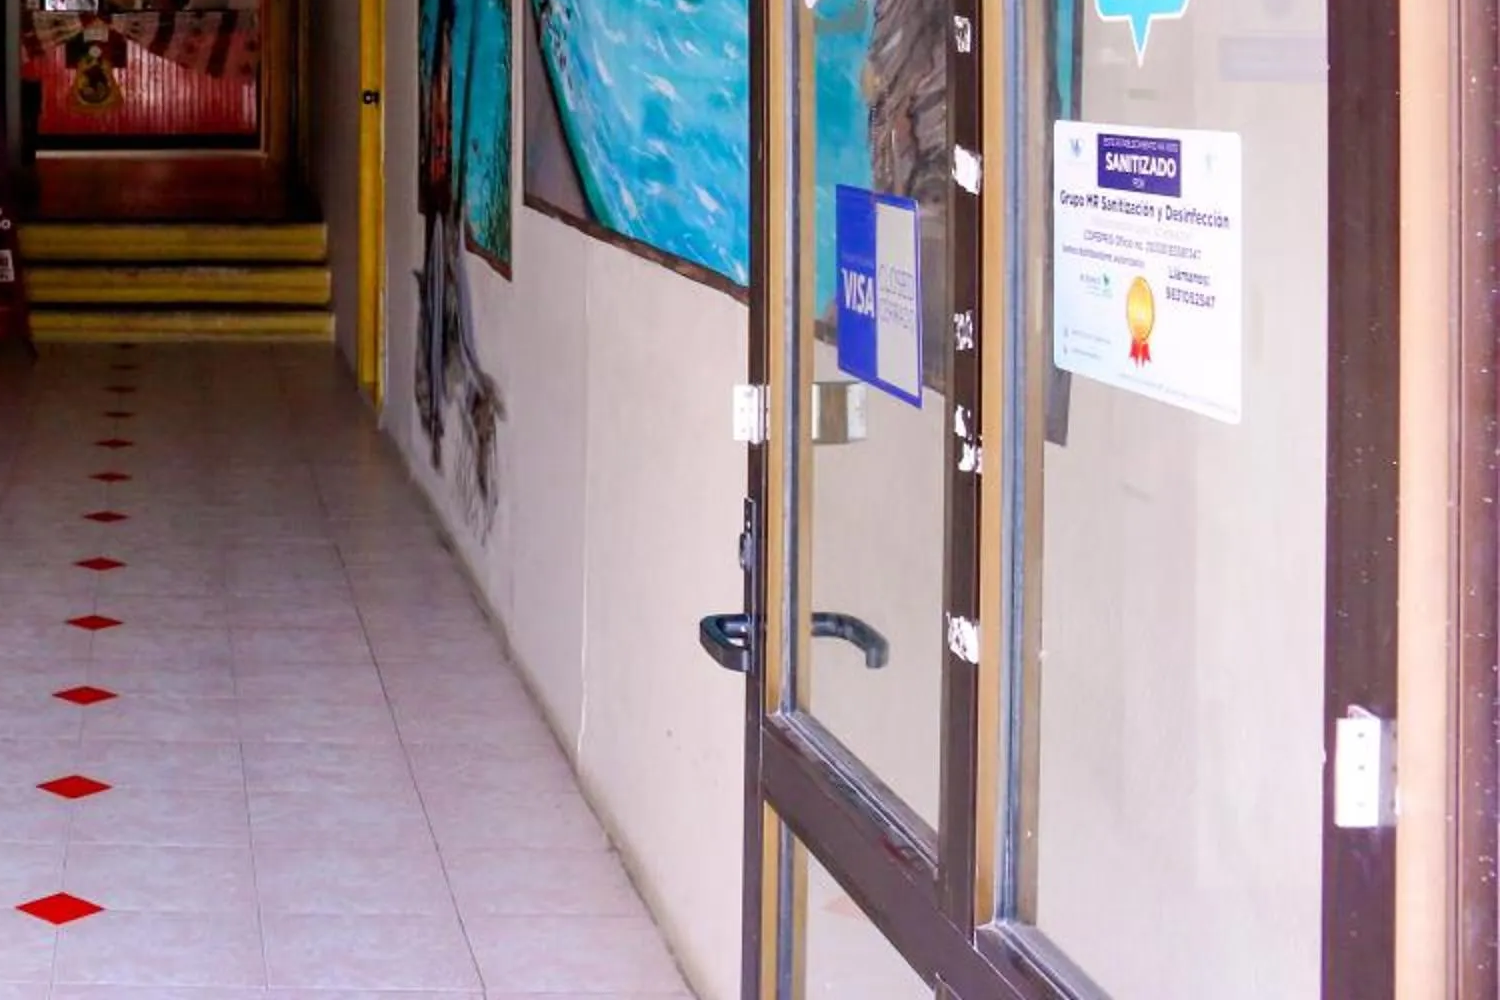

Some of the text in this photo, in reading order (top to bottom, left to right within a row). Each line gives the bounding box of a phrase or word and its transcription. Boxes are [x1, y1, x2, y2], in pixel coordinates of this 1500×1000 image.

[1105, 152, 1177, 178] SANITIZADO
[1060, 190, 1084, 208] Grupo
[1157, 207, 1162, 222] y
[841, 267, 875, 319] VISA
